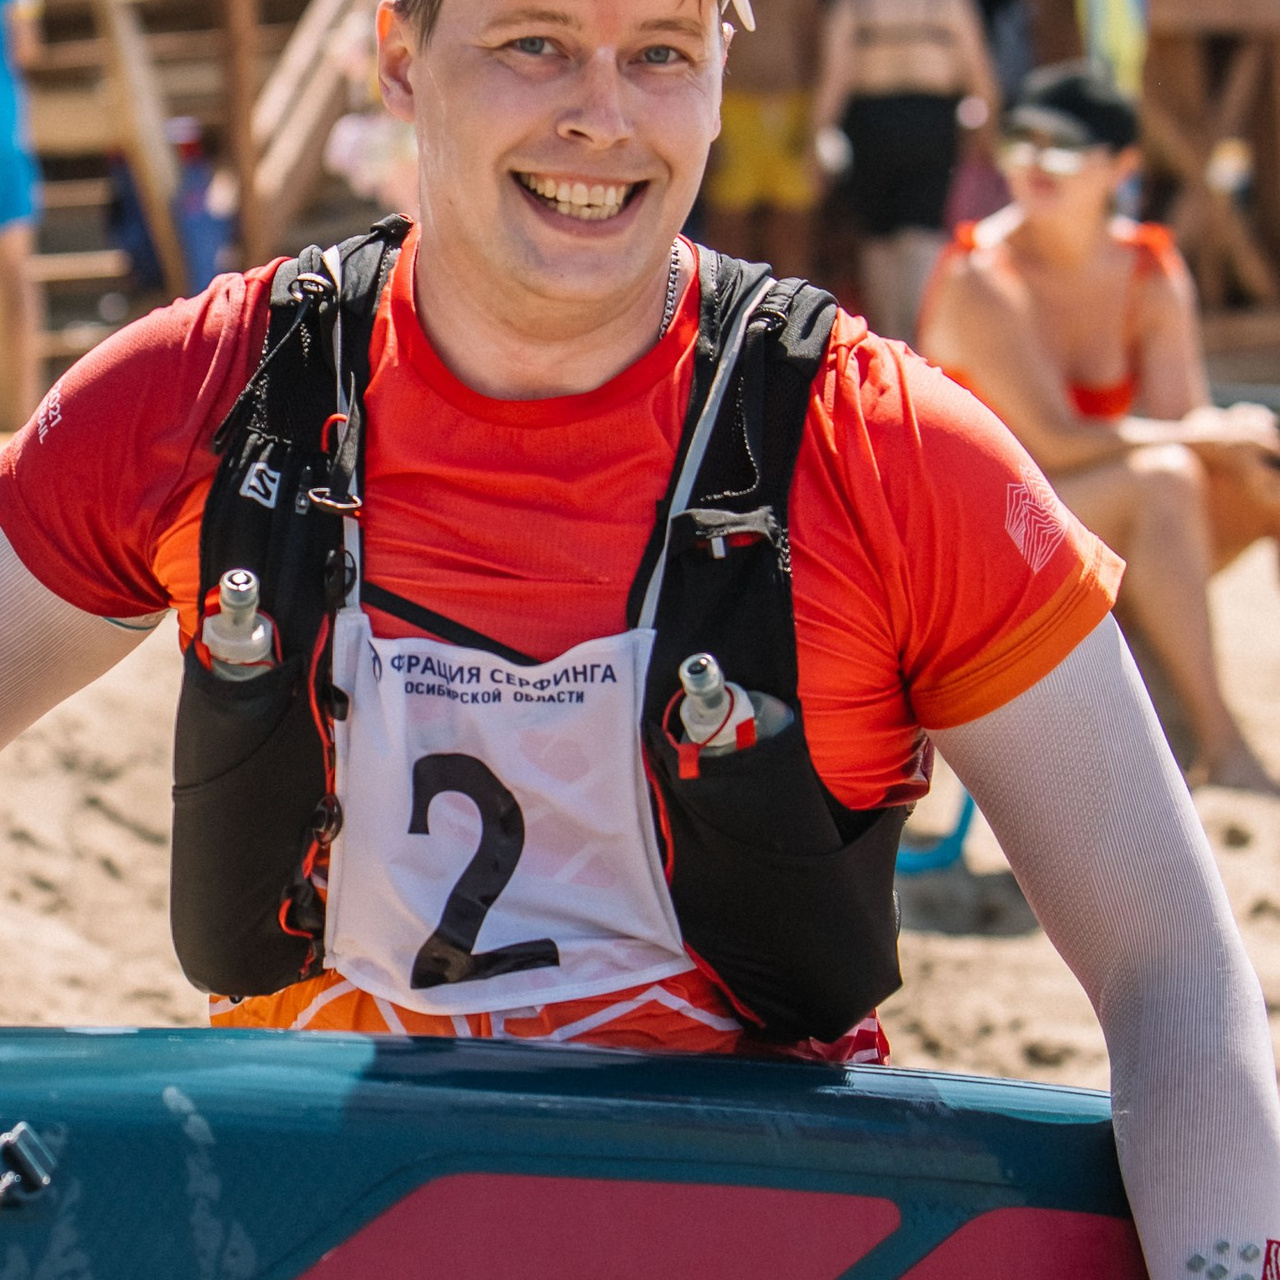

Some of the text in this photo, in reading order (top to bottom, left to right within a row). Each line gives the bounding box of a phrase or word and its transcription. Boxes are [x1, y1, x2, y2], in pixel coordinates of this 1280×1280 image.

[47, 381, 62, 428] 2021
[390, 653, 617, 691] ФРАЦИЯ СЕРФИНГА
[404, 681, 585, 704] ОСИБИРСКОЙ ОБЛАСТИ
[407, 752, 560, 990] 2
